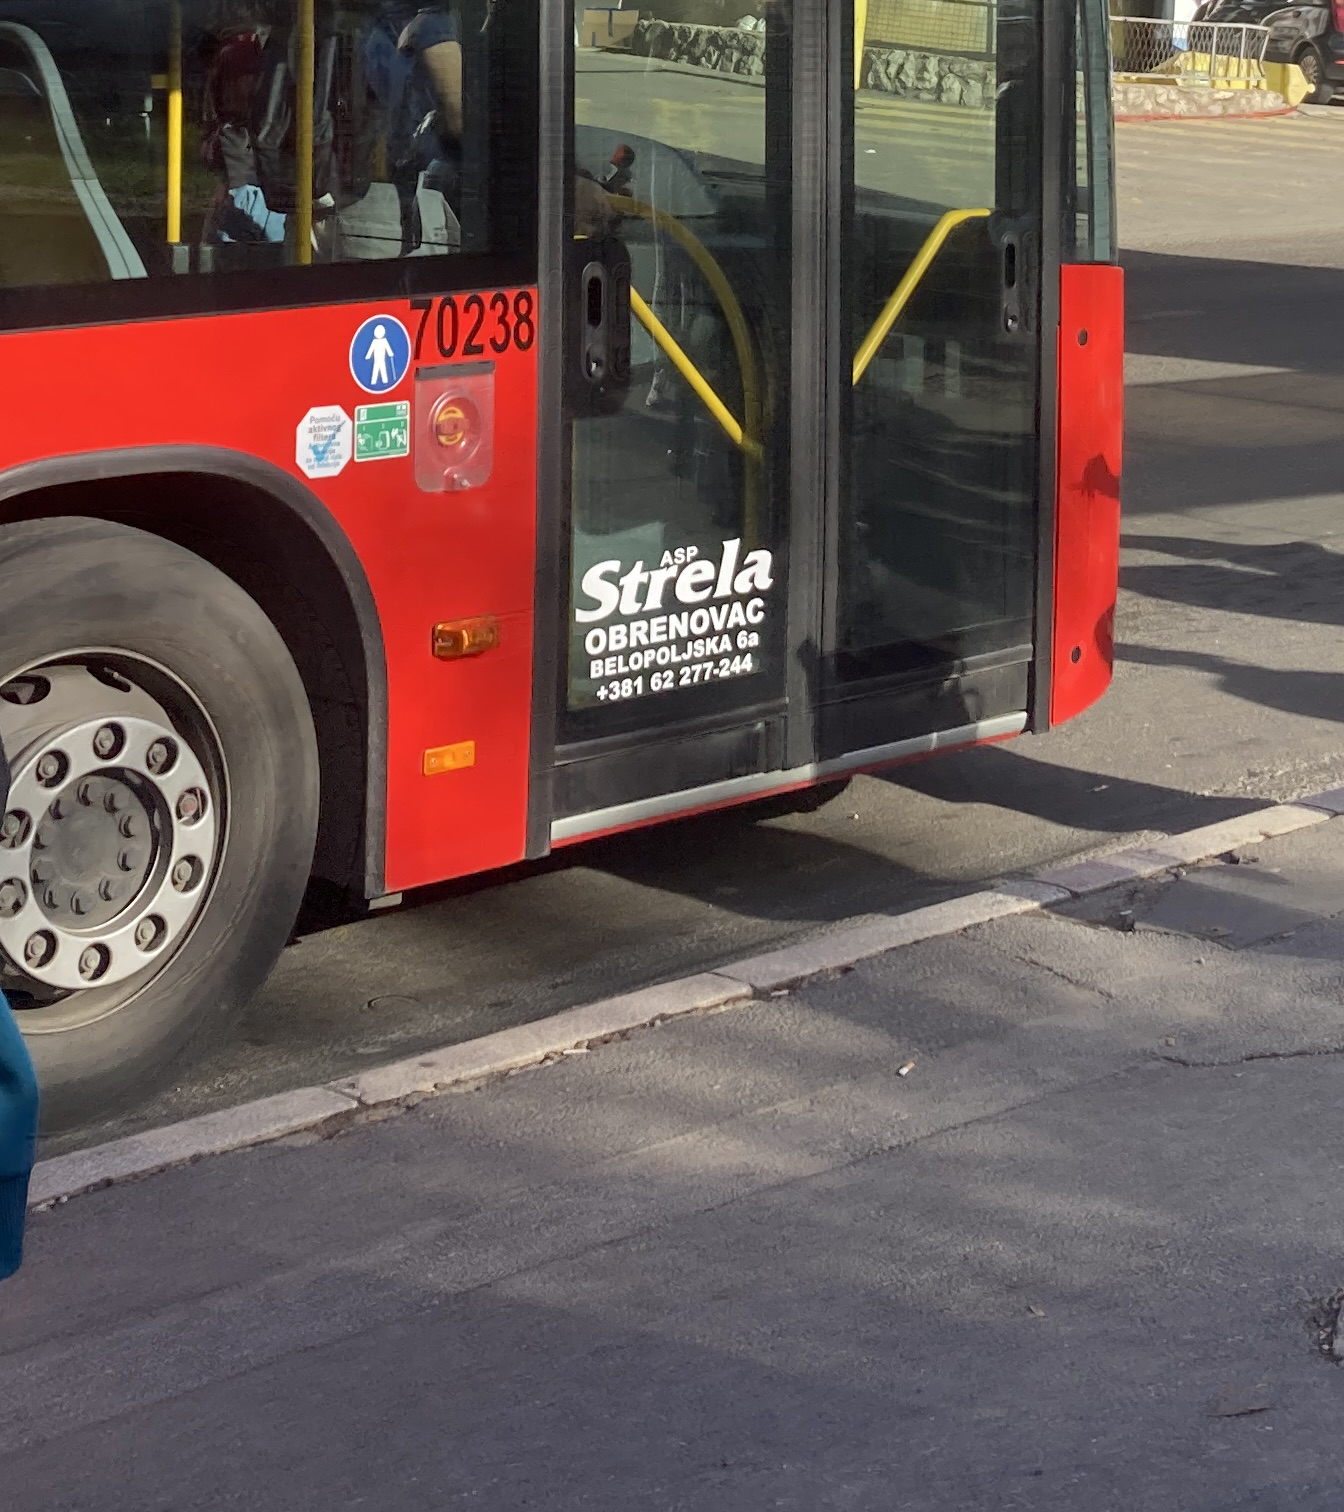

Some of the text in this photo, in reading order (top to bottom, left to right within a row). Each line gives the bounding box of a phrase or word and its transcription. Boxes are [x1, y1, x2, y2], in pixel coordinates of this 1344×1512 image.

[410, 290, 536, 361] 70238
[575, 538, 774, 623] Strela
[660, 545, 699, 567] ASP
[585, 597, 765, 656] OBRENOVAC
[590, 629, 760, 679] BELOPOLJSKA 6a
[596, 653, 753, 701] +381 62 277-244
